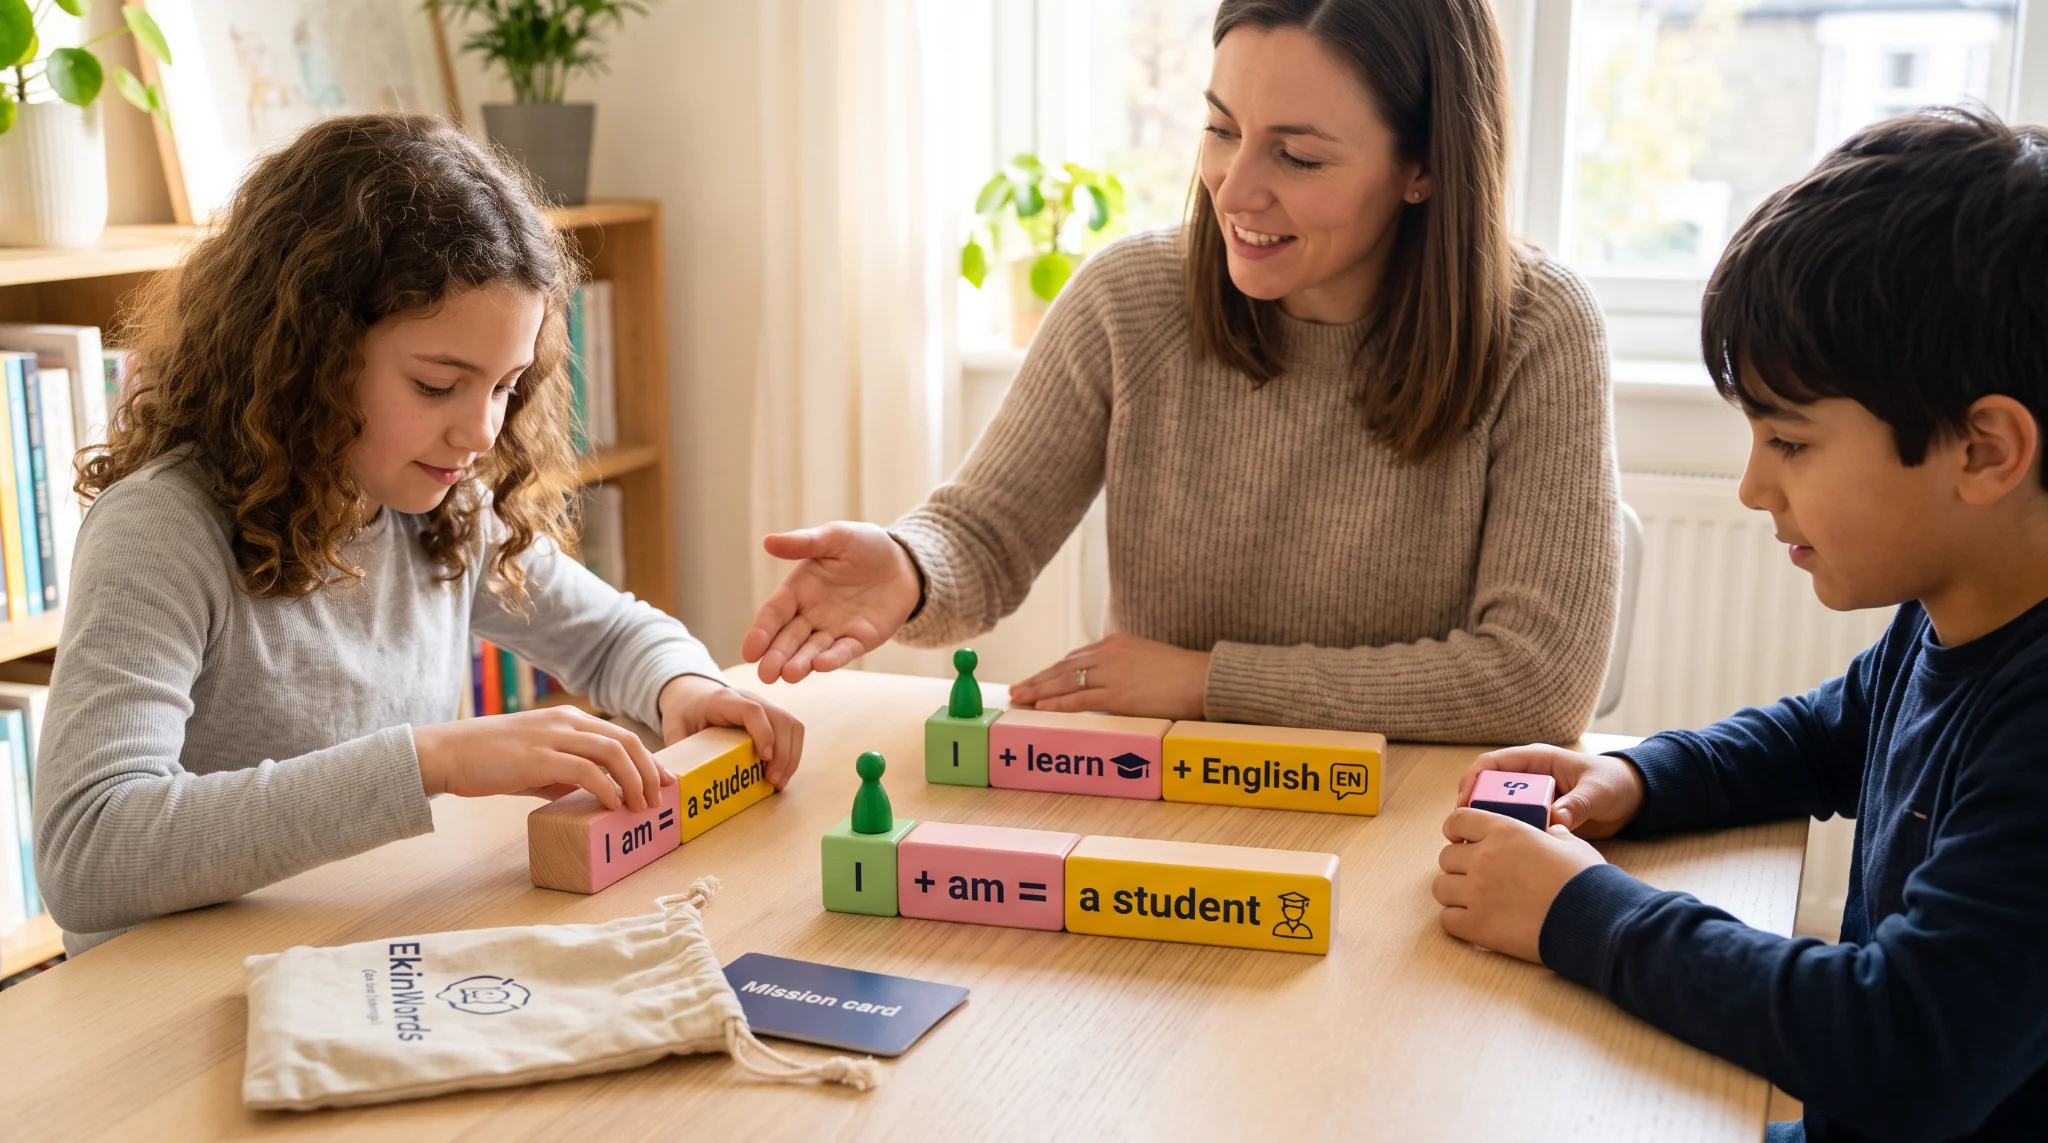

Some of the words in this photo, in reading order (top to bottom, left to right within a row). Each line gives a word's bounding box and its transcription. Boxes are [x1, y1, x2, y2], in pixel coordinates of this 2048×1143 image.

[952, 741, 959, 768] I
[1027, 743, 1104, 777] learn
[1202, 757, 1320, 793] English
[1336, 771, 1361, 788] EN
[687, 795, 699, 818] a
[605, 833, 611, 864] I
[621, 820, 653, 855] am
[855, 861, 862, 893] I
[948, 875, 1005, 904] am
[1079, 887, 1101, 913] a
[1112, 886, 1261, 926] student
[389, 942, 431, 1041] EkinWords
[740, 980, 839, 1007] Mission
[842, 1000, 903, 1018] card
